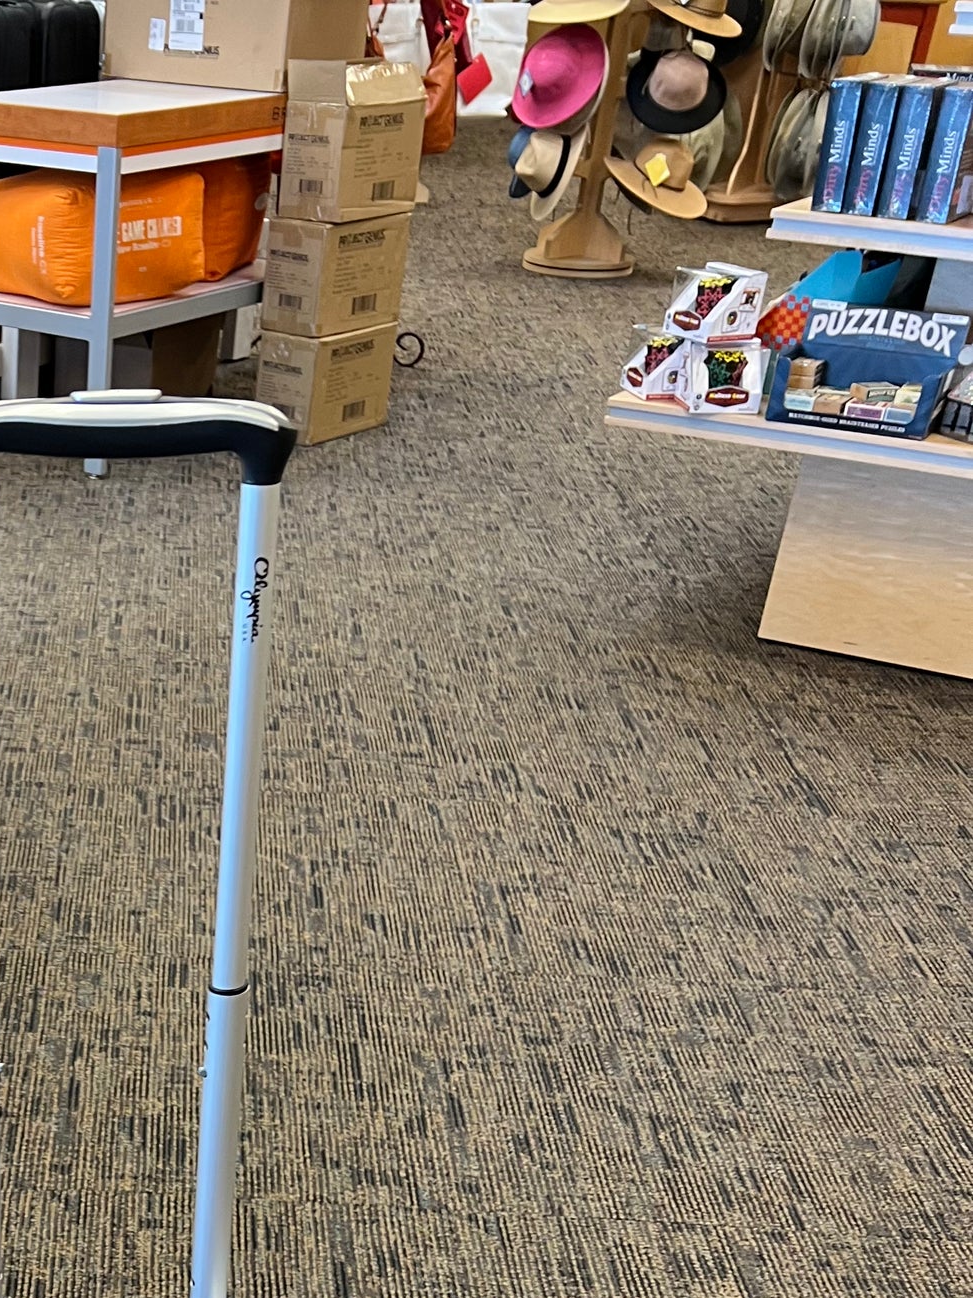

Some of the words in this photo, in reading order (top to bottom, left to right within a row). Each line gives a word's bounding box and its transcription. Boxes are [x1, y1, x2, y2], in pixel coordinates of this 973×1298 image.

[828, 120, 846, 163] Minds
[861, 122, 880, 166] Minds
[897, 127, 916, 171] Minds
[936, 131, 957, 174] Minds
[807, 308, 957, 358] PUZZLEBOX
[240, 557, 269, 643] Olympia
